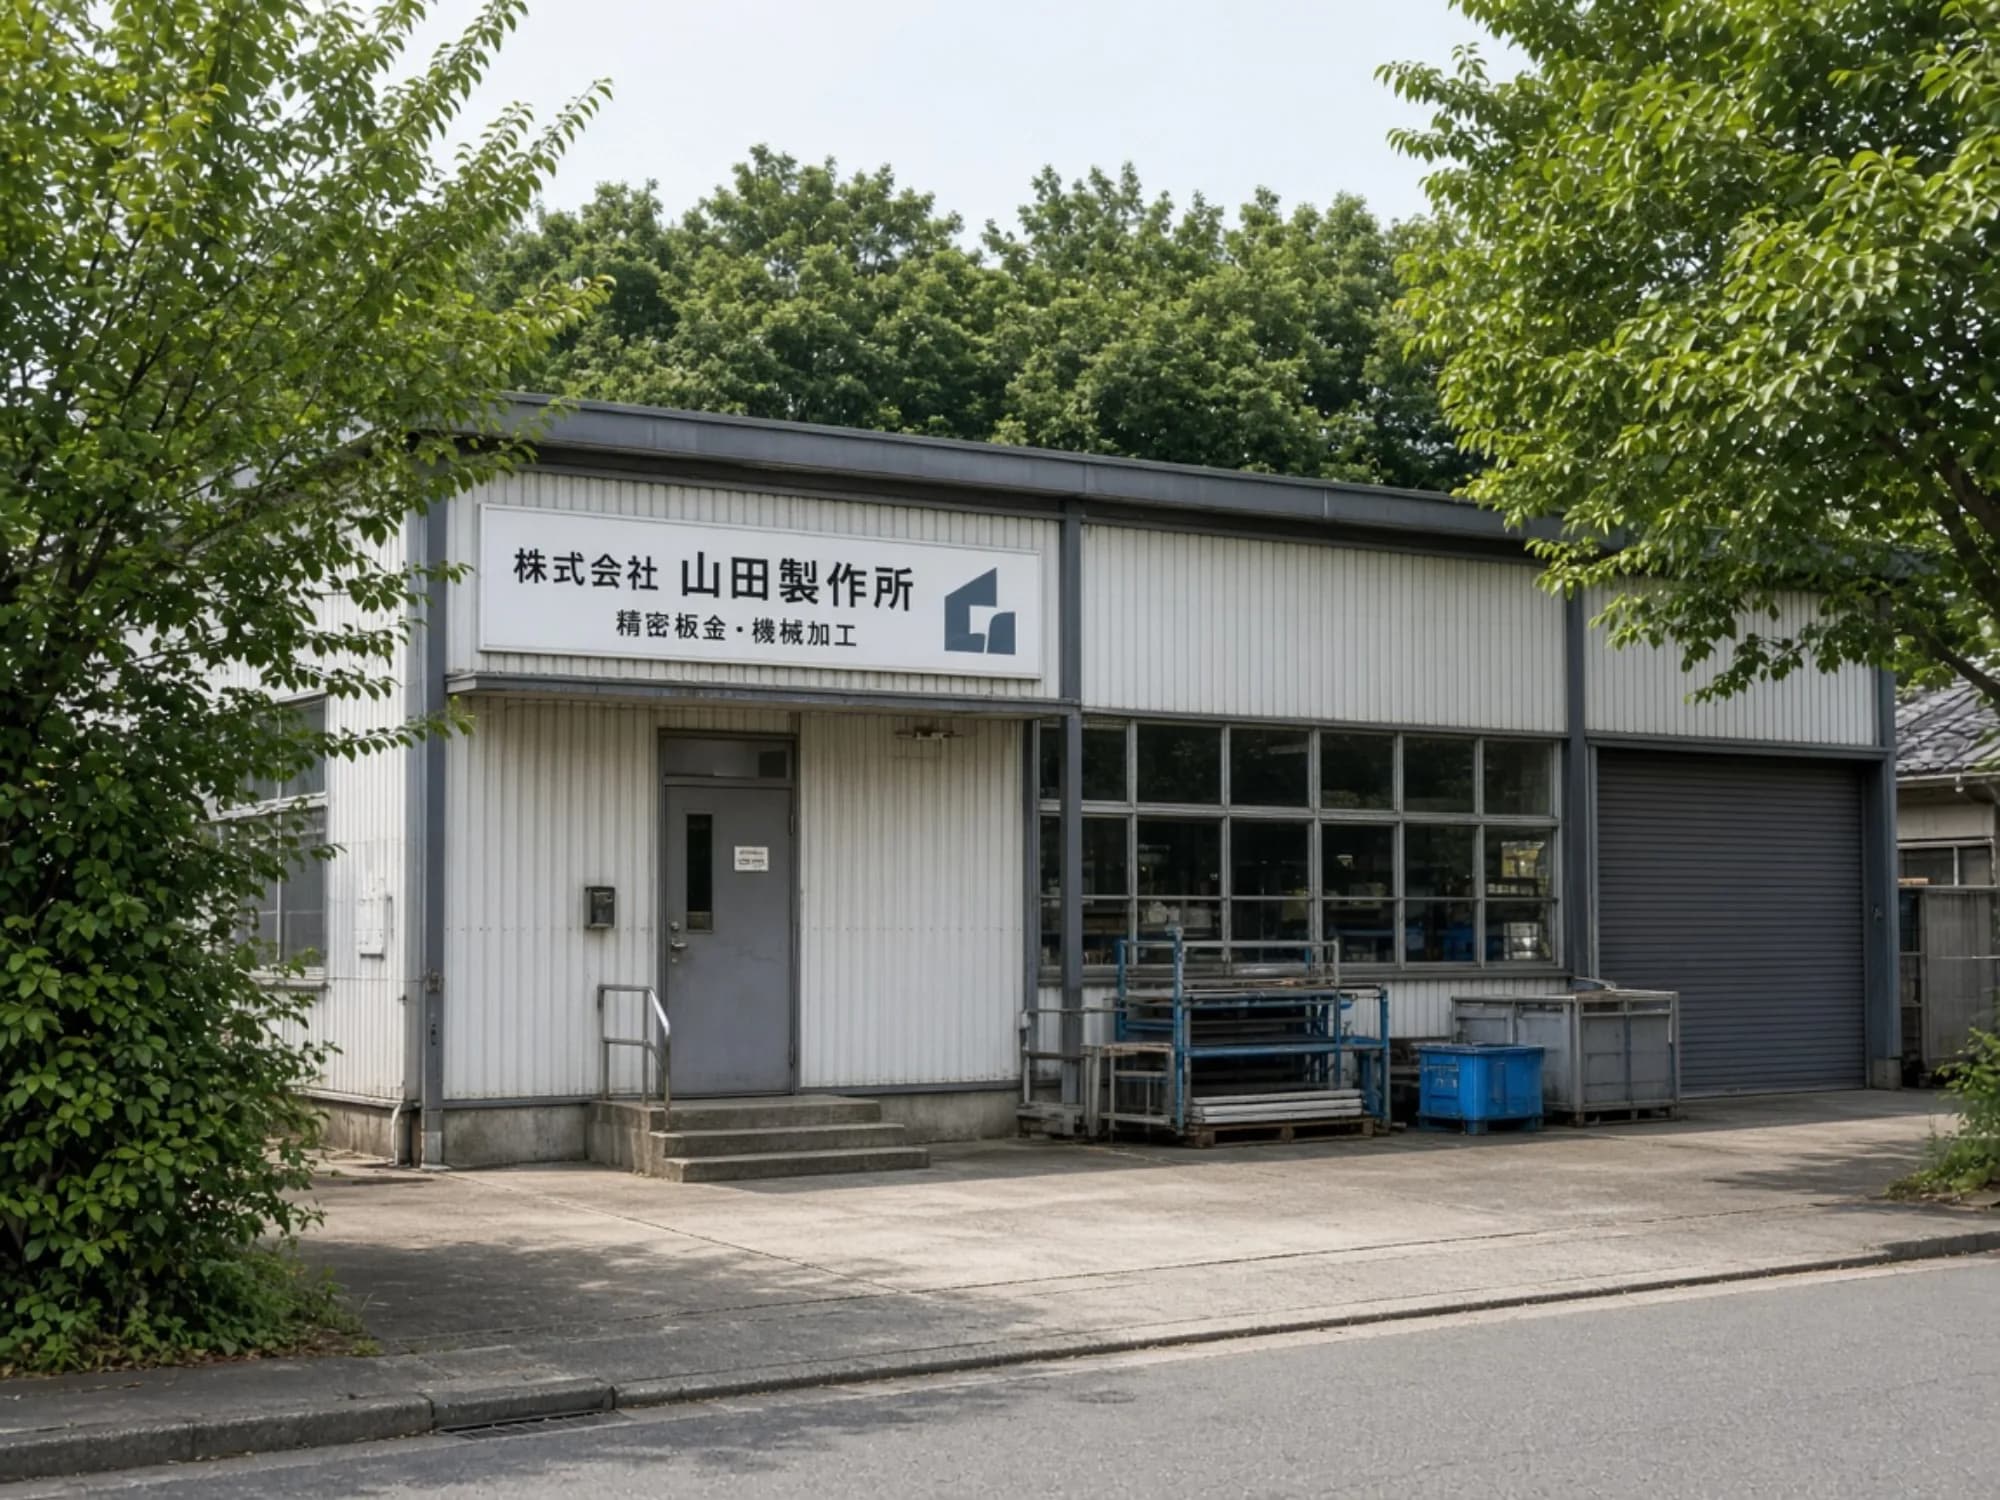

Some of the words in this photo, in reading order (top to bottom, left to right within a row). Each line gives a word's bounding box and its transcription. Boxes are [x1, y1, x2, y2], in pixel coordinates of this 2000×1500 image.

[513, 547, 659, 591] 株式会社
[680, 551, 914, 612] 山田製作所
[616, 609, 858, 648] 精密板金・機械加工
